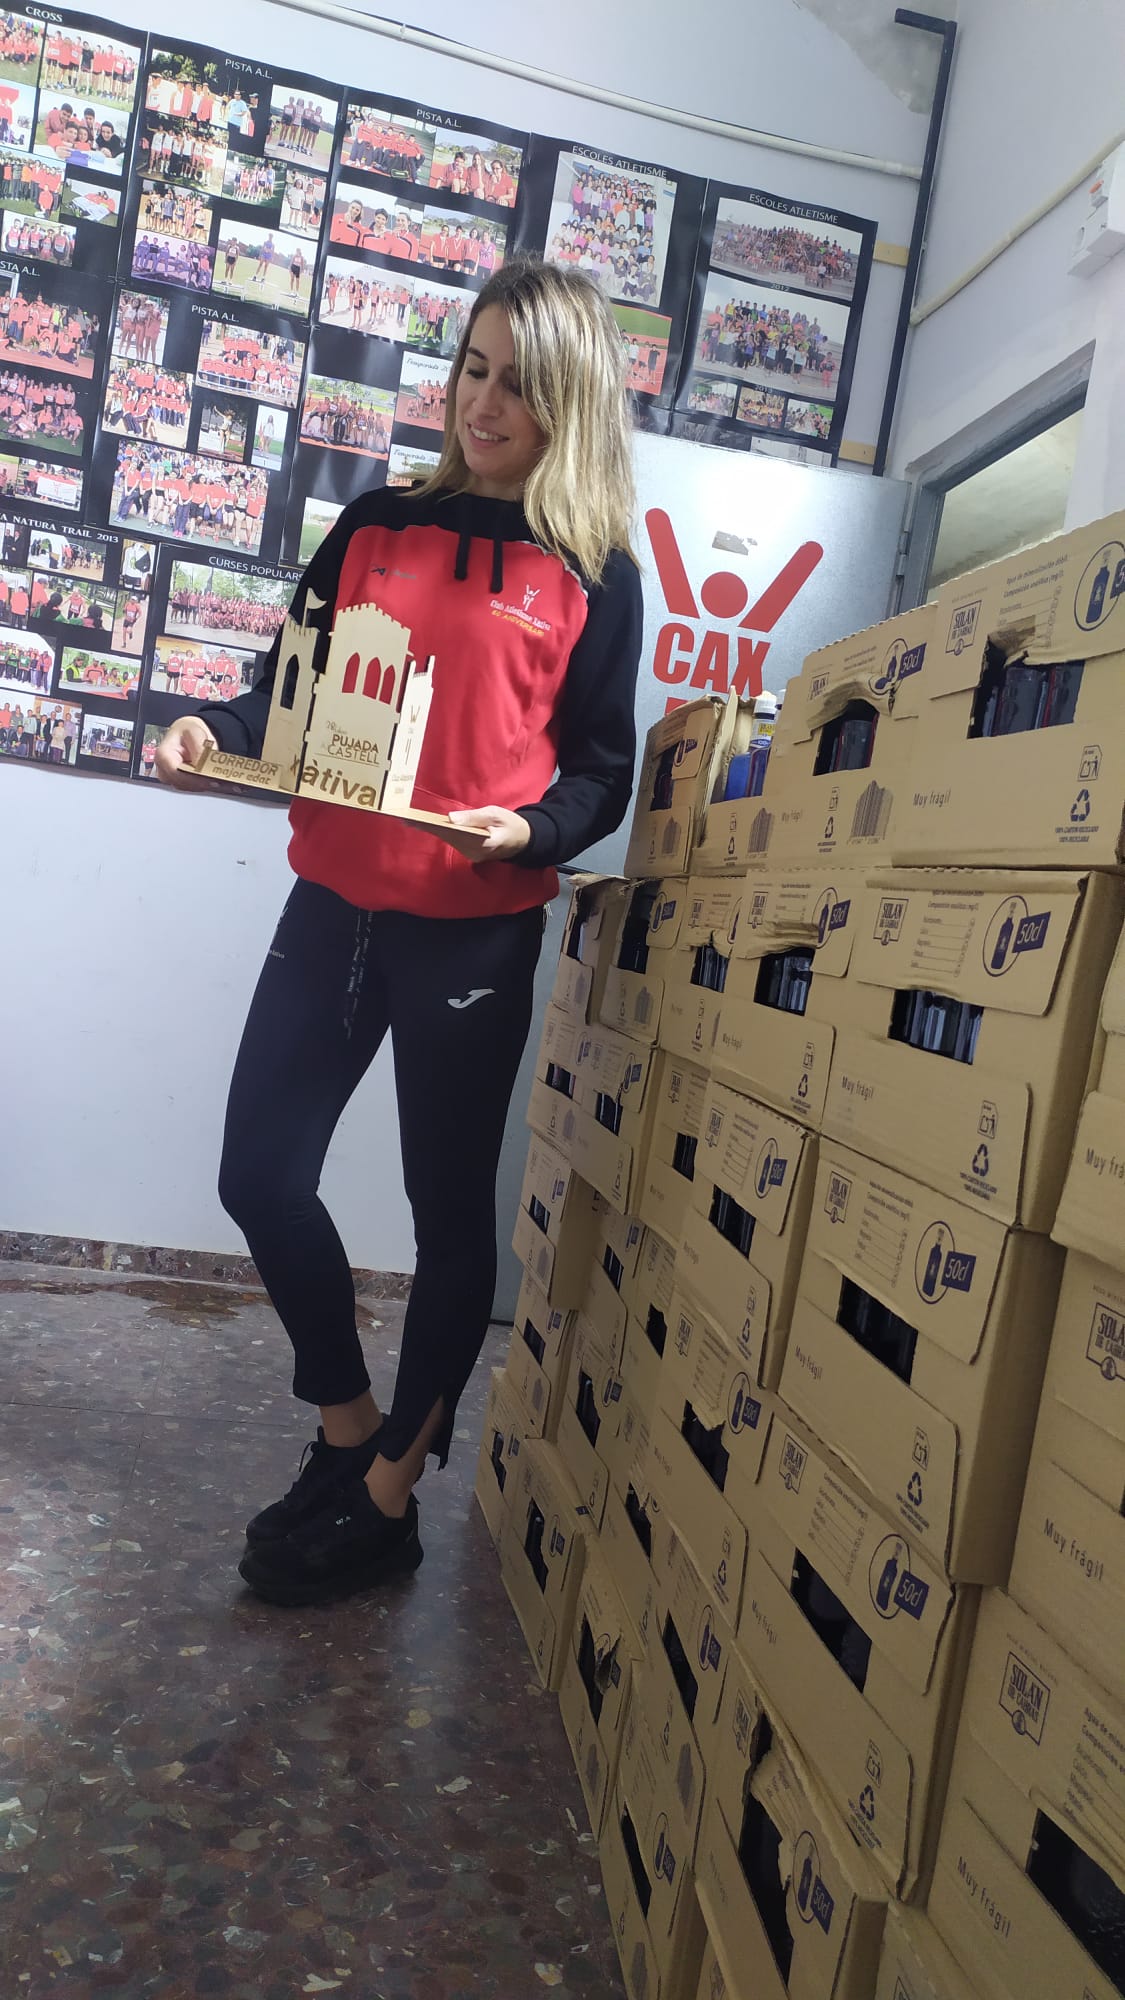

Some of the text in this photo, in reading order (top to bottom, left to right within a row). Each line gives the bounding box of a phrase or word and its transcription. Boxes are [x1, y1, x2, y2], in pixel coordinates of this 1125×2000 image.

[25, 6, 63, 23] CROSS
[225, 58, 273, 80] PISTA A.L.
[416, 108, 462, 129] PISTA A.L.
[572, 145, 667, 178] ESCOLES ATLETISME
[749, 193, 839, 224] ESCOLES ATLETISME
[22, 265, 41, 277] A.L.
[191, 304, 240, 323] PISTA A.L.
[13, 516, 57, 531] NATURA
[61, 525, 93, 538] TRAIL
[97, 533, 119, 543] 2013
[208, 556, 249, 572] CURSES
[953, 606, 977, 630] SOLAN
[653, 622, 771, 702] CAX
[900, 648, 921, 674] 50cl
[327, 744, 380, 765] CASTELL
[332, 733, 379, 754] PUJADA
[210, 751, 279, 777] CORREDOR
[212, 766, 272, 785] major edat
[913, 787, 951, 808] Muy frágil
[882, 902, 904, 920] SOLAN
[1017, 918, 1045, 945] 50cl
[842, 1076, 874, 1101] Muy frágil
[1086, 1147, 1125, 1185] Muy frá
[832, 1177, 848, 1200] SOLAN
[945, 1257, 970, 1282] 50cl
[1098, 1312, 1125, 1347] SOLA
[795, 1345, 823, 1381] Muy frágil
[785, 1441, 804, 1471] SOLAN
[1043, 1517, 1104, 1581] Muy frágil
[897, 1578, 922, 1606] 50cl
[1010, 1663, 1044, 1711] SOLAN
[1007, 1683, 1040, 1724] DE CABRAS
[957, 1855, 1011, 1939] Muy frágil
